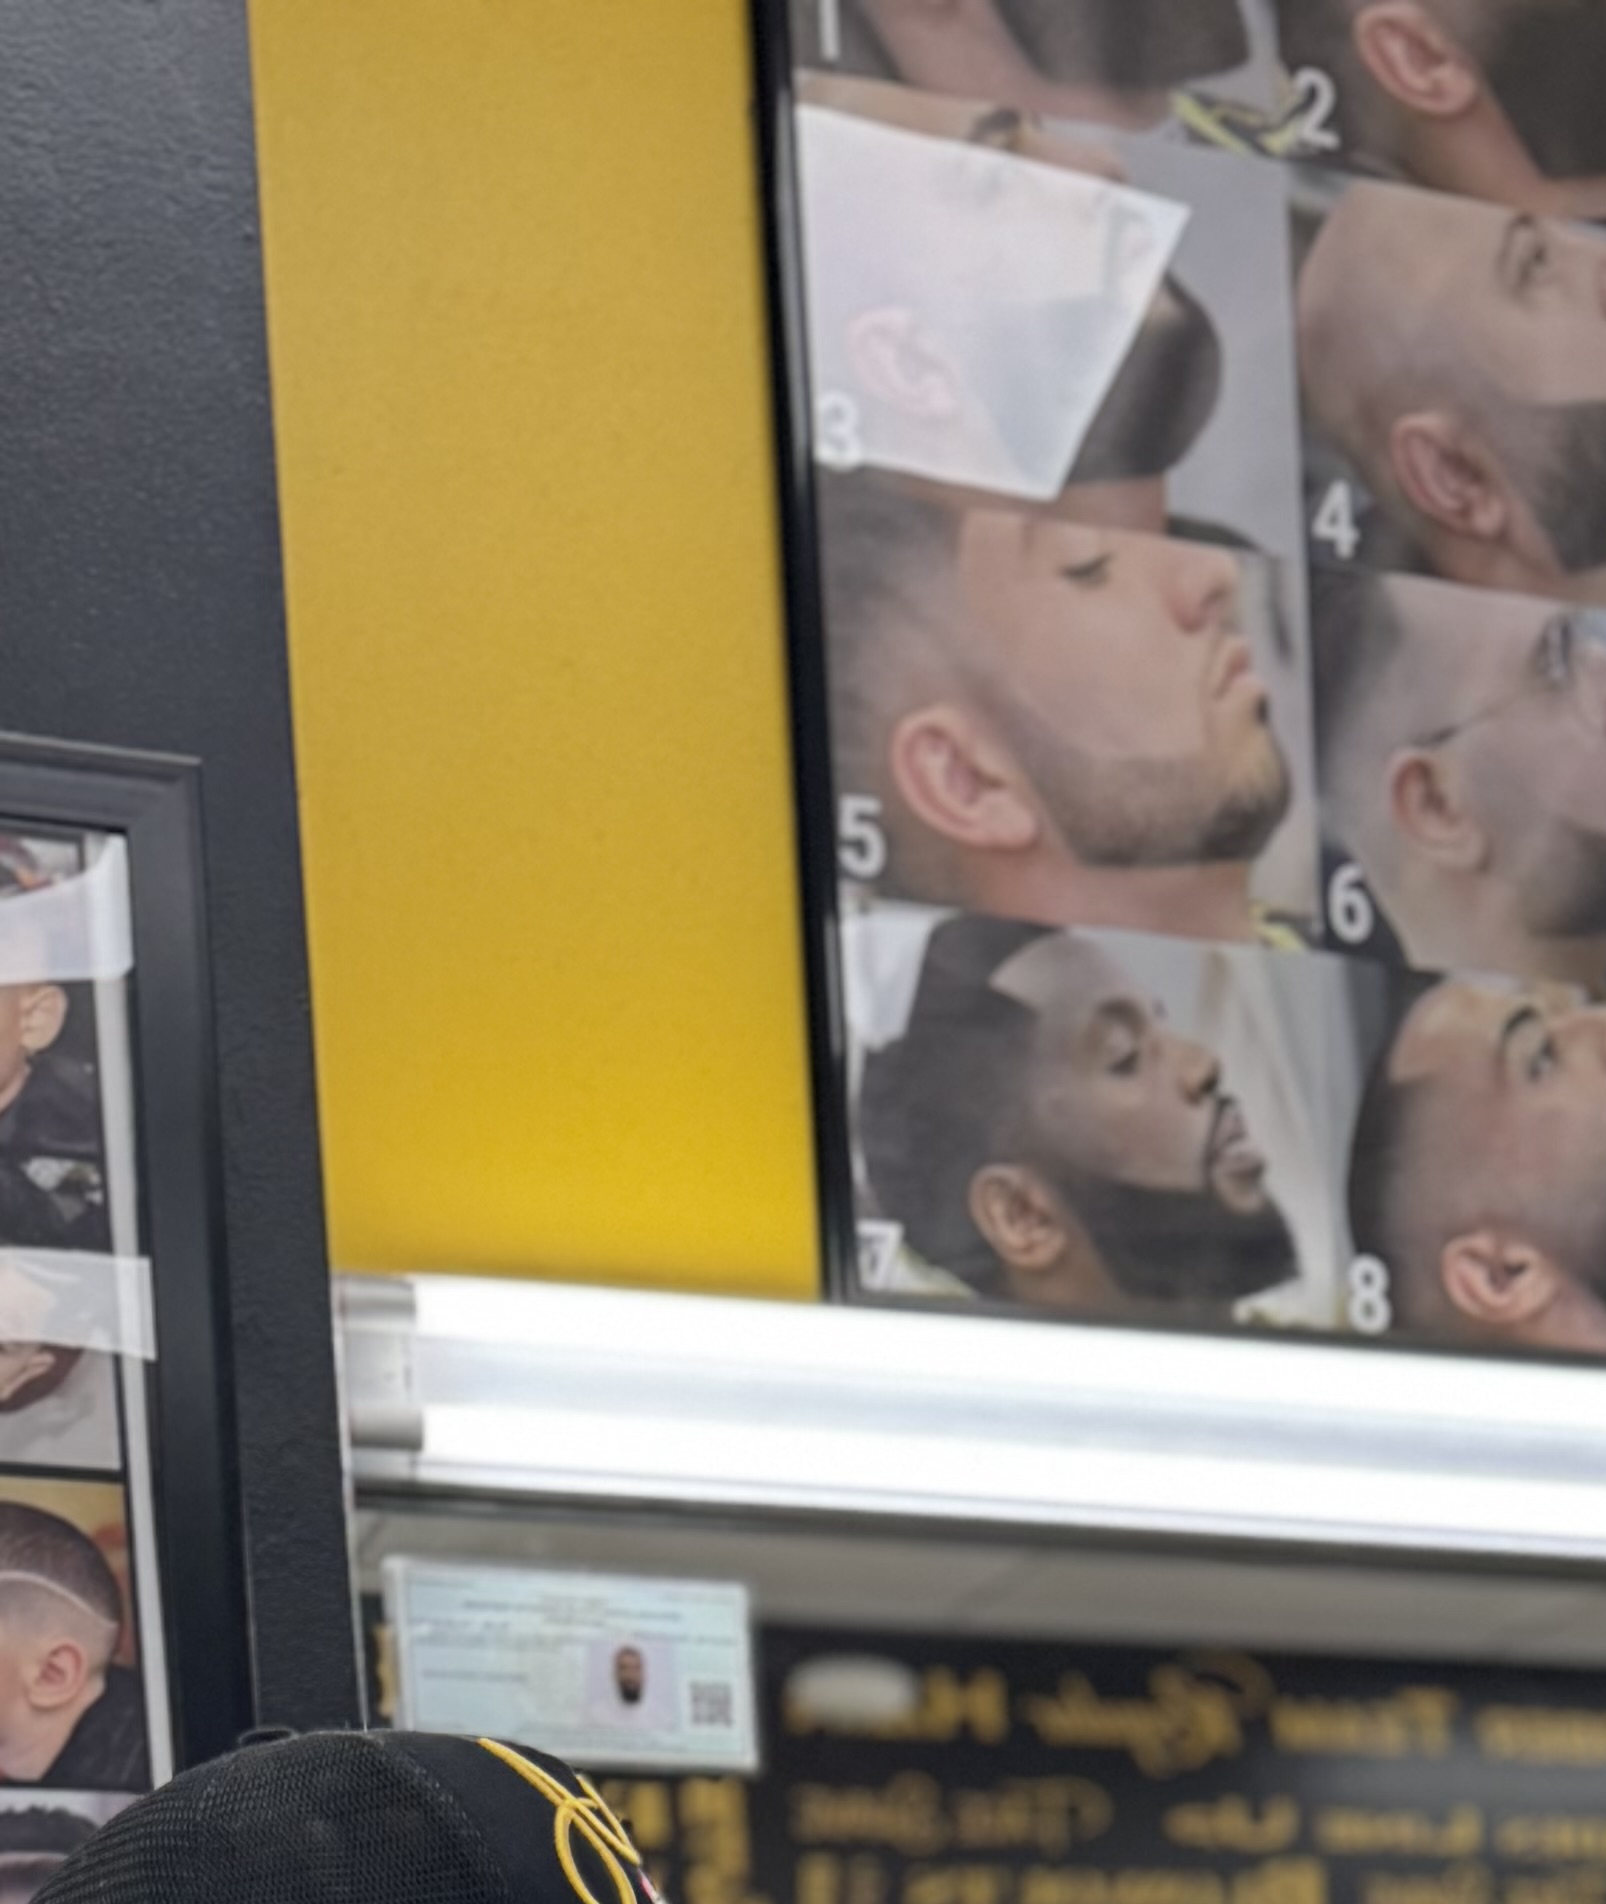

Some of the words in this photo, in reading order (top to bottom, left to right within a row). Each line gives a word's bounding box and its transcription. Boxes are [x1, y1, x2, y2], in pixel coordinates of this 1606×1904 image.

[1295, 67, 1340, 150] 2
[1311, 480, 1360, 560] 4
[837, 793, 886, 879] 5
[1328, 862, 1373, 946] 6
[857, 1217, 904, 1292] 7
[1348, 1253, 1392, 1336] 8
